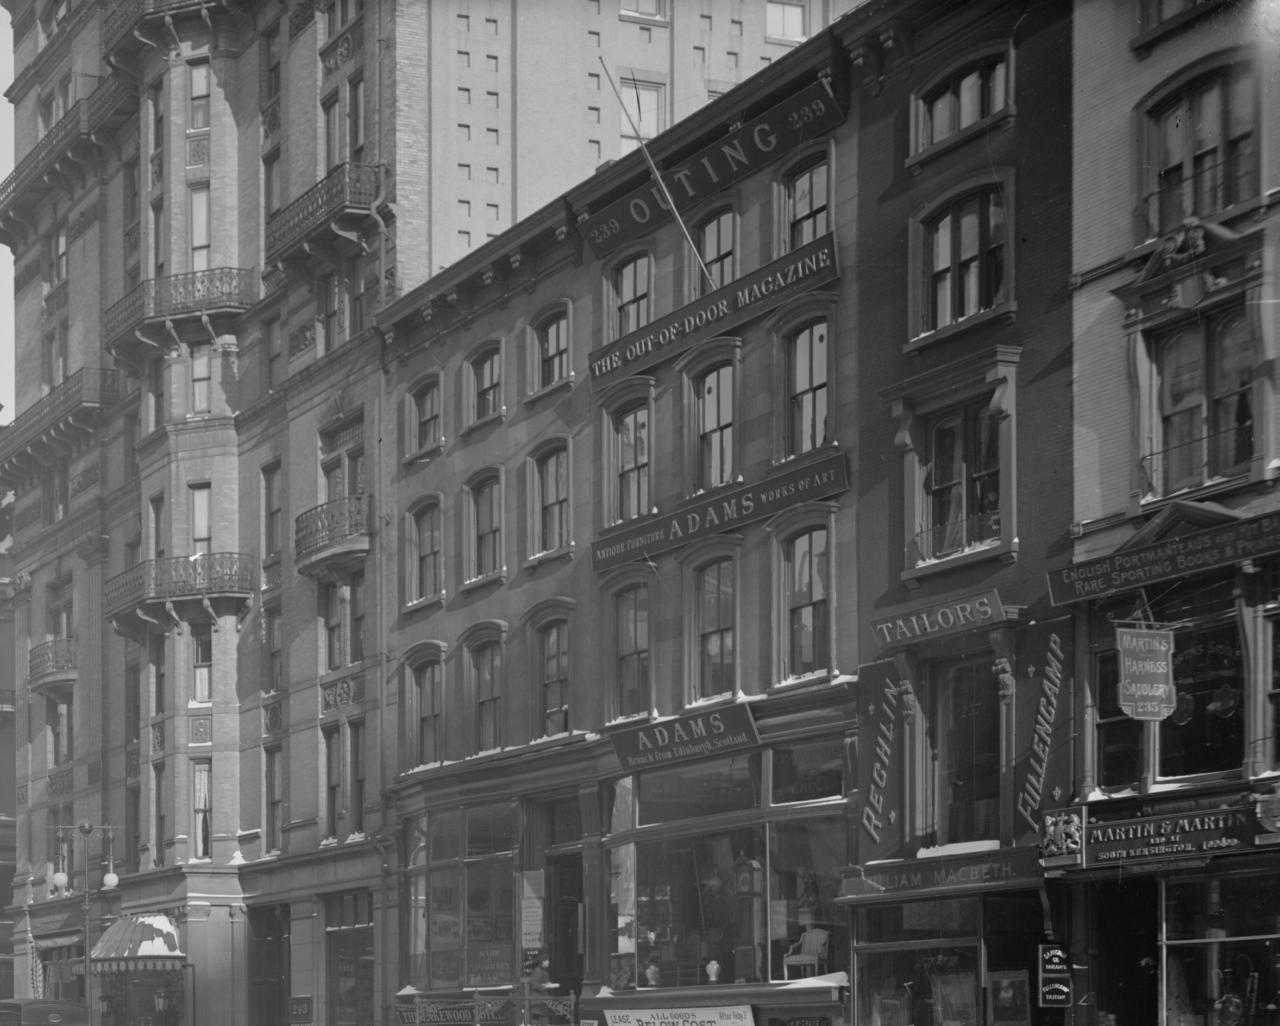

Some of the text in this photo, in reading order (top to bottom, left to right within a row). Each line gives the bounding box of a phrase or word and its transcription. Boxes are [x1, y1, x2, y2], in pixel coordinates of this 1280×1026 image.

[590, 98, 827, 244] 239 OUTING 239
[591, 247, 831, 378] THE OUT-OF-DOOR MAGAZINE
[596, 469, 836, 562] ANTIQUE FURNITURE ADAMS WORKS OF ART
[1062, 558, 1112, 584] ENGLISH
[1114, 535, 1213, 570] PORTMANTEAUS
[1074, 577, 1107, 596] RARE
[1111, 560, 1172, 586] SPORTING
[1177, 548, 1221, 569] BOOKS
[877, 597, 993, 644] TAILORS
[1122, 633, 1169, 652] MARTIN'S
[1124, 656, 1169, 675] HARNESS
[1123, 678, 1171, 698] SADDLERY
[1137, 701, 1159, 713] 235
[637, 712, 725, 751] ADAMS
[1018, 632, 1065, 833] FULLENCAMP
[627, 753, 655, 767] Branch
[655, 748, 673, 762] from
[713, 731, 749, 750] Scotland.
[861, 677, 900, 844] RECHLIN
[1090, 812, 1248, 844] MARTIN & MARTIN
[1170, 834, 1181, 842] AT
[1097, 850, 1127, 860] SOUTH
[863, 861, 1017, 892] WILLIAM MACBETH.
[469, 972, 511, 981] TAILORS
[610, 1014, 632, 1024] LEASE
[650, 1013, 669, 1021] ALL
[670, 1012, 697, 1020] GOODS
